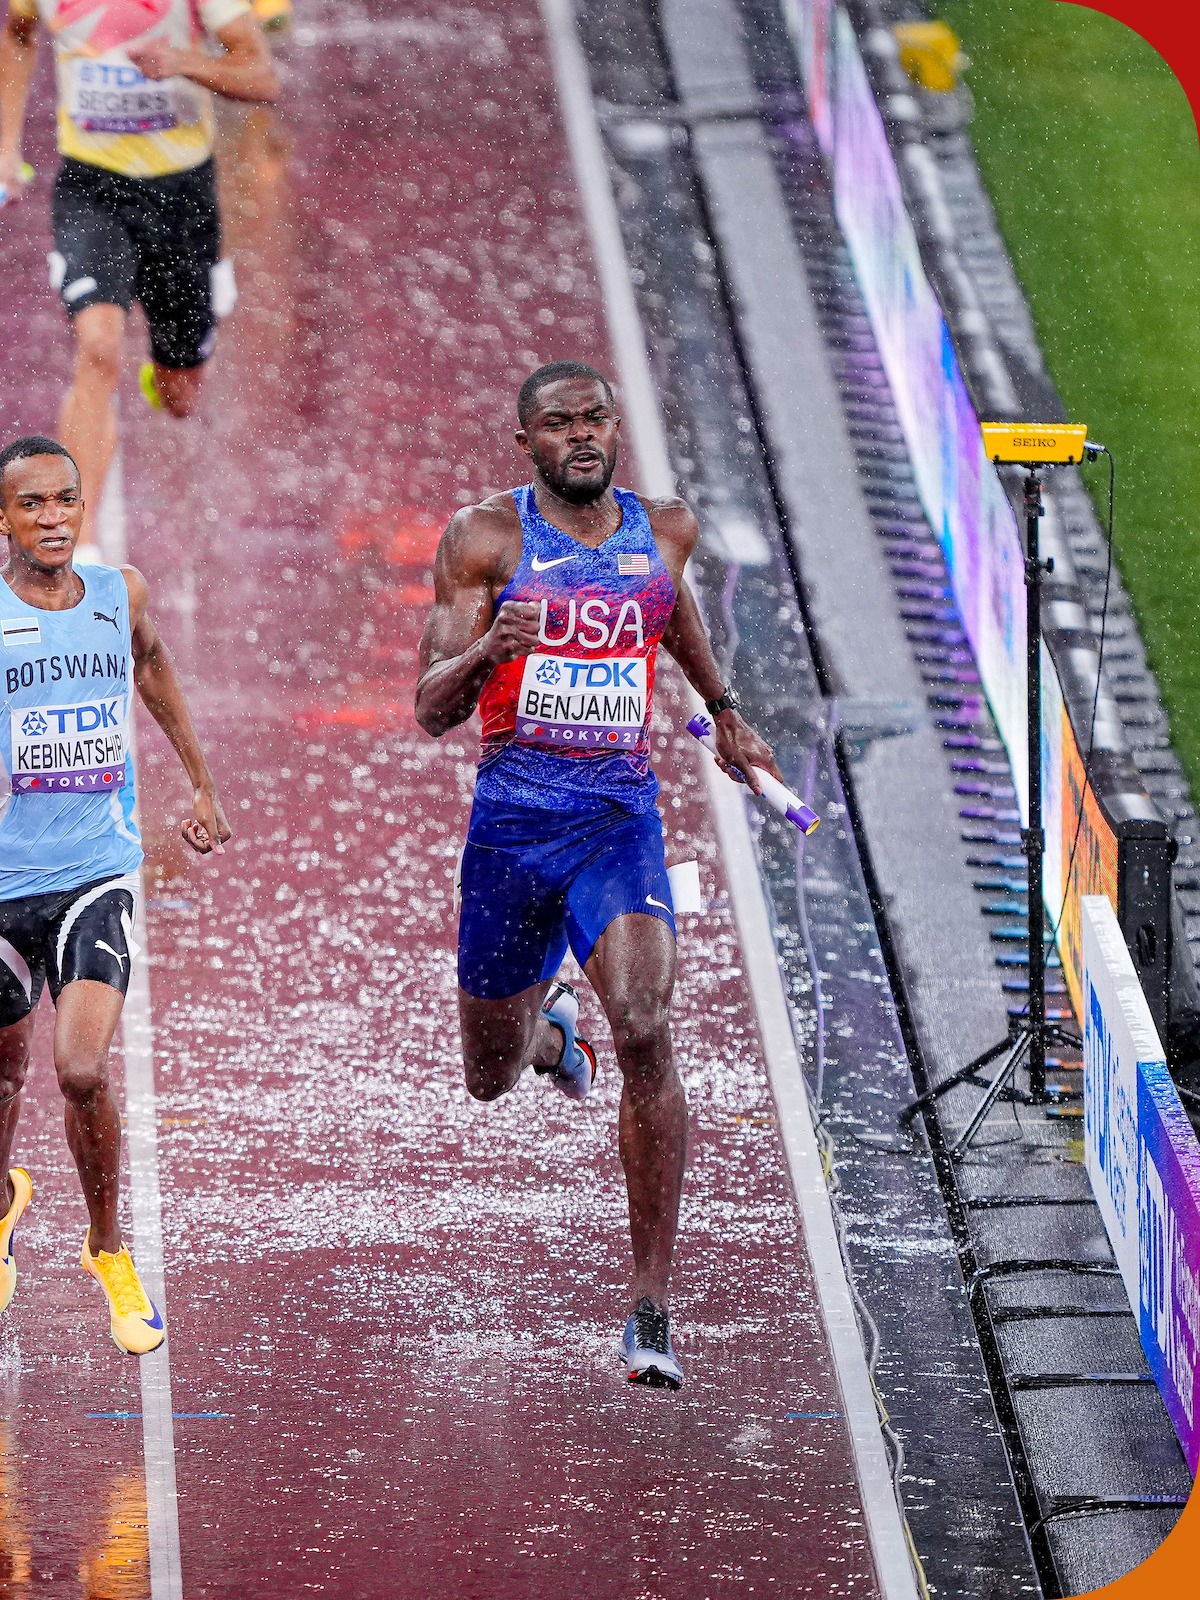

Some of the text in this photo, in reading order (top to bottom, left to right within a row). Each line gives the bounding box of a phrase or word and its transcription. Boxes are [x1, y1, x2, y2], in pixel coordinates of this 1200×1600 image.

[96, 63, 148, 88] TD
[1013, 437, 1056, 448] SEIKO
[538, 599, 645, 649] USA
[5, 653, 126, 694] BOTSWANA
[563, 662, 638, 688] TDK
[46, 700, 119, 734] TDK
[525, 689, 641, 723] BENJAMIN
